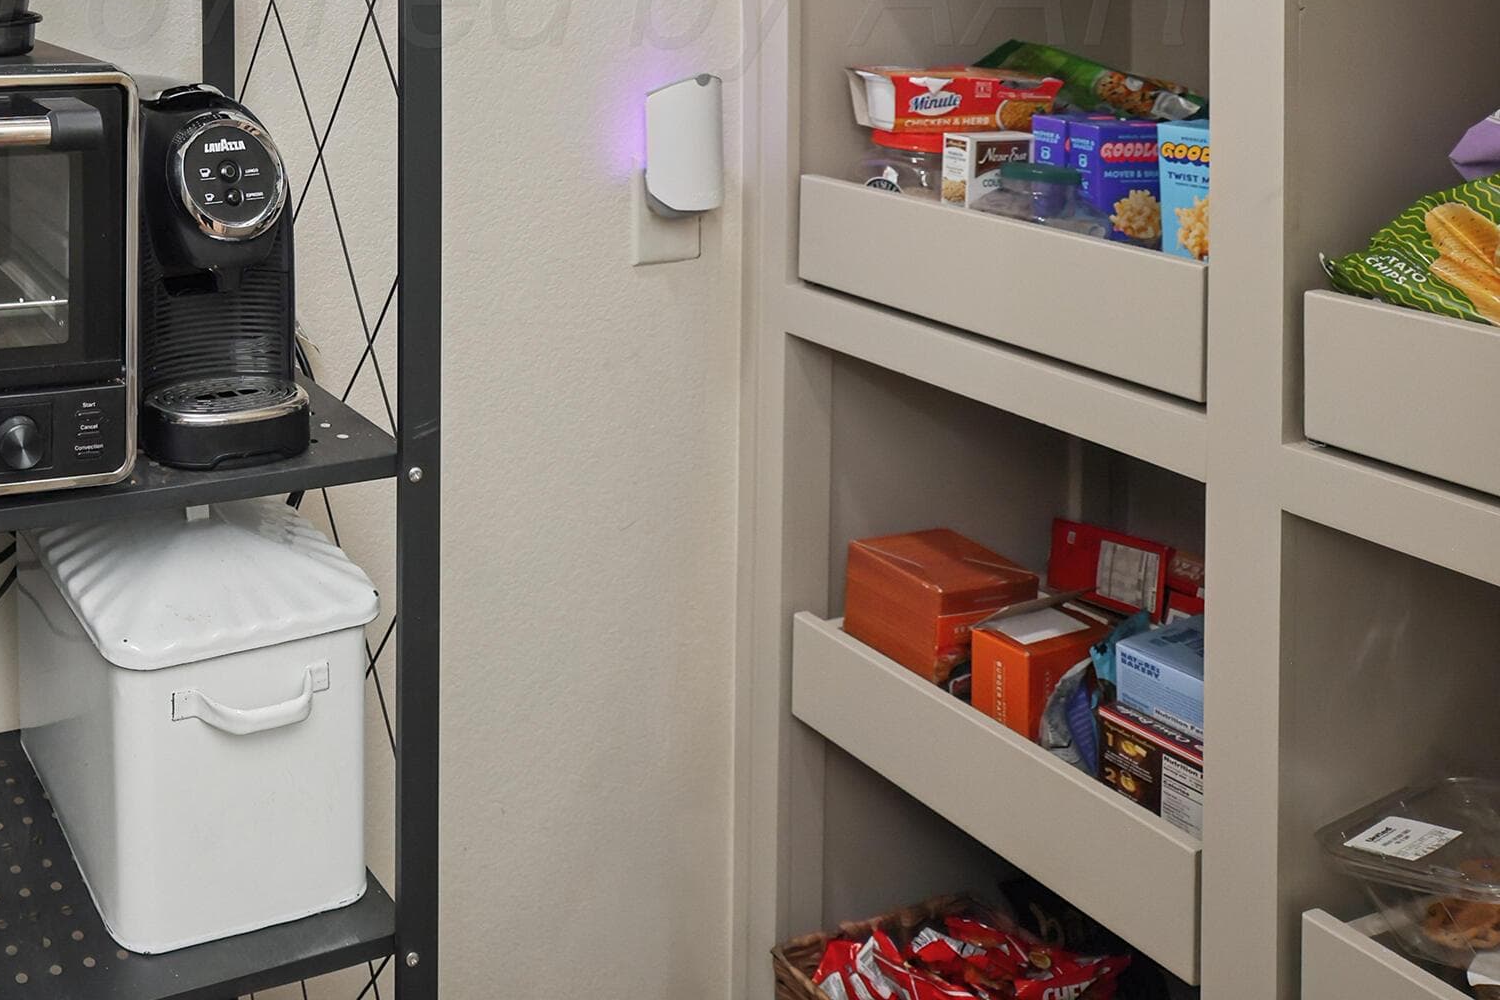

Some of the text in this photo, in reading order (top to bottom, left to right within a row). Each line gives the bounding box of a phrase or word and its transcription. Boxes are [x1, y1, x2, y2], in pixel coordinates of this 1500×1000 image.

[910, 94, 962, 111] Minute
[905, 117, 951, 127] CHICKEN
[204, 139, 246, 153] LAVAZZA
[1168, 171, 1199, 183] TWIST
[1365, 257, 1407, 285] CHIPS
[1163, 755, 1199, 778] Nutrition
